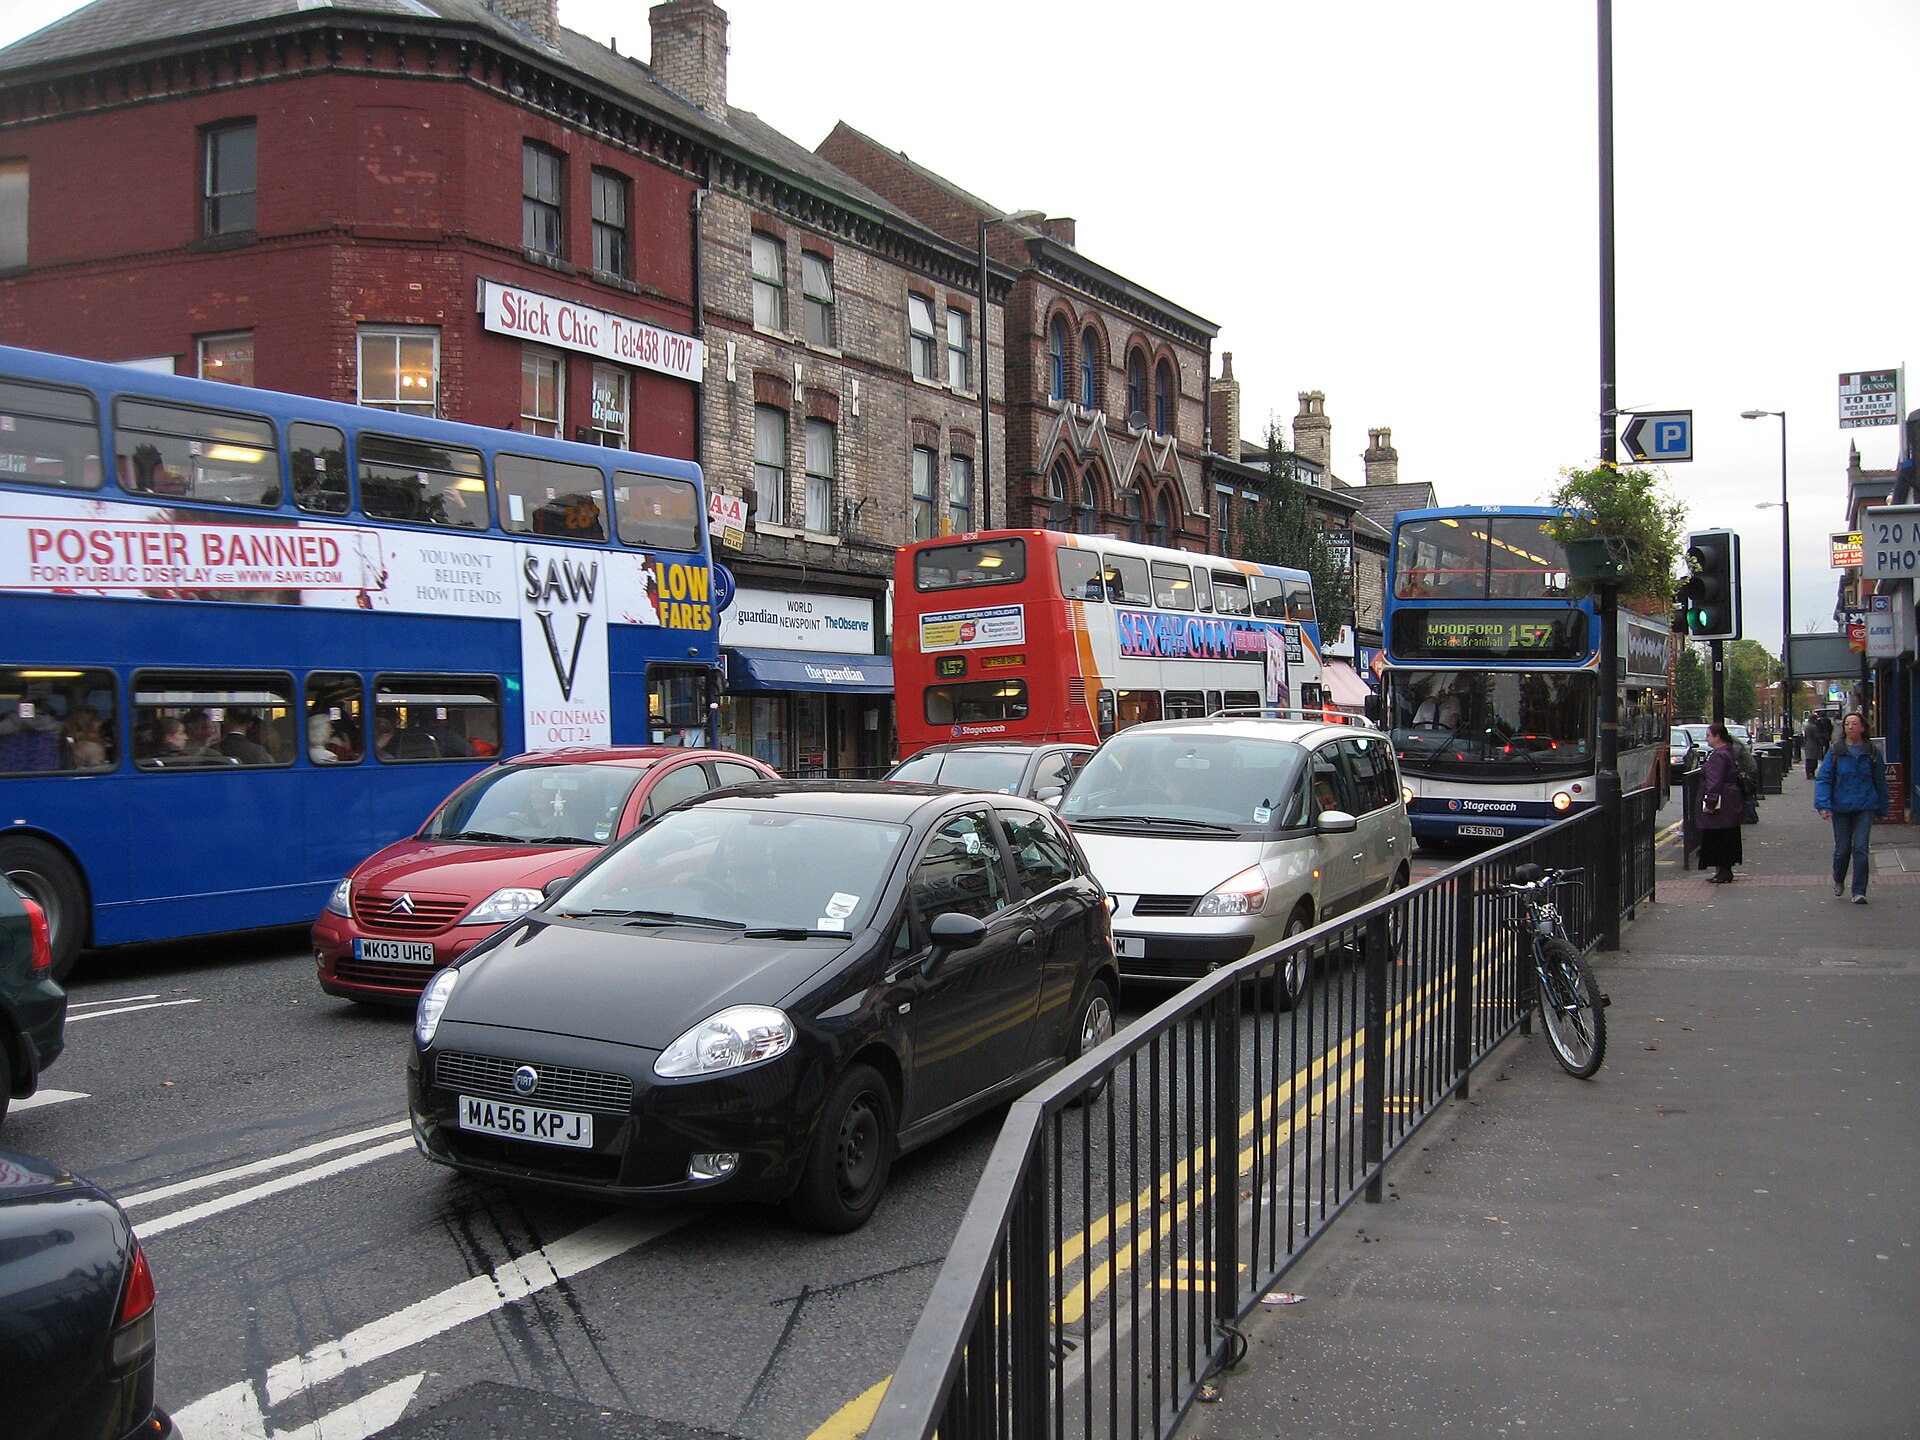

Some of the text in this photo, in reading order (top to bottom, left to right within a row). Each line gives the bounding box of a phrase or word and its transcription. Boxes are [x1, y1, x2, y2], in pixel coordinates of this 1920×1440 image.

[501, 291, 693, 373] Slick Chic Tel:438 0707
[1861, 383, 1894, 391] GUNSON
[1844, 393, 1893, 404] TO LET
[1662, 425, 1681, 449] P
[28, 528, 340, 568] POSTER BANNED
[732, 541, 742, 549] LET
[419, 549, 448, 565] YOU
[31, 566, 69, 582] FOR
[75, 566, 139, 583] PUBLIC
[142, 567, 213, 584] DISPLAY
[215, 572, 236, 583] SEE
[434, 568, 482, 586] BELIEVE
[524, 555, 598, 604] SAW
[655, 562, 709, 602] LOW
[416, 585, 502, 605] HOW IT ENDS
[786, 600, 813, 614] WORLD
[659, 601, 712, 632] FARES
[738, 608, 779, 626] guardian
[779, 616, 821, 631] NEWSPOINT
[1160, 615, 1184, 636] AND
[1120, 611, 1163, 656] SEX
[1185, 617, 1234, 659] CITY
[1428, 624, 1503, 635] WOODFORD
[1508, 624, 1552, 648] 157
[1160, 636, 1186, 658] THE
[1463, 635, 1503, 647] Bramhall
[535, 610, 592, 703] V
[942, 660, 964, 674] 157
[530, 710, 605, 725] IN CINEMAS
[548, 727, 591, 742] OCT 24
[962, 724, 1006, 736] Stagecoach
[1463, 801, 1517, 813] Stagecoach
[1460, 827, 1503, 836] W636 RND
[363, 941, 433, 962] WK03 UHG
[516, 1075, 533, 1086] FIAT
[468, 1100, 581, 1141] MA56 KPJ
